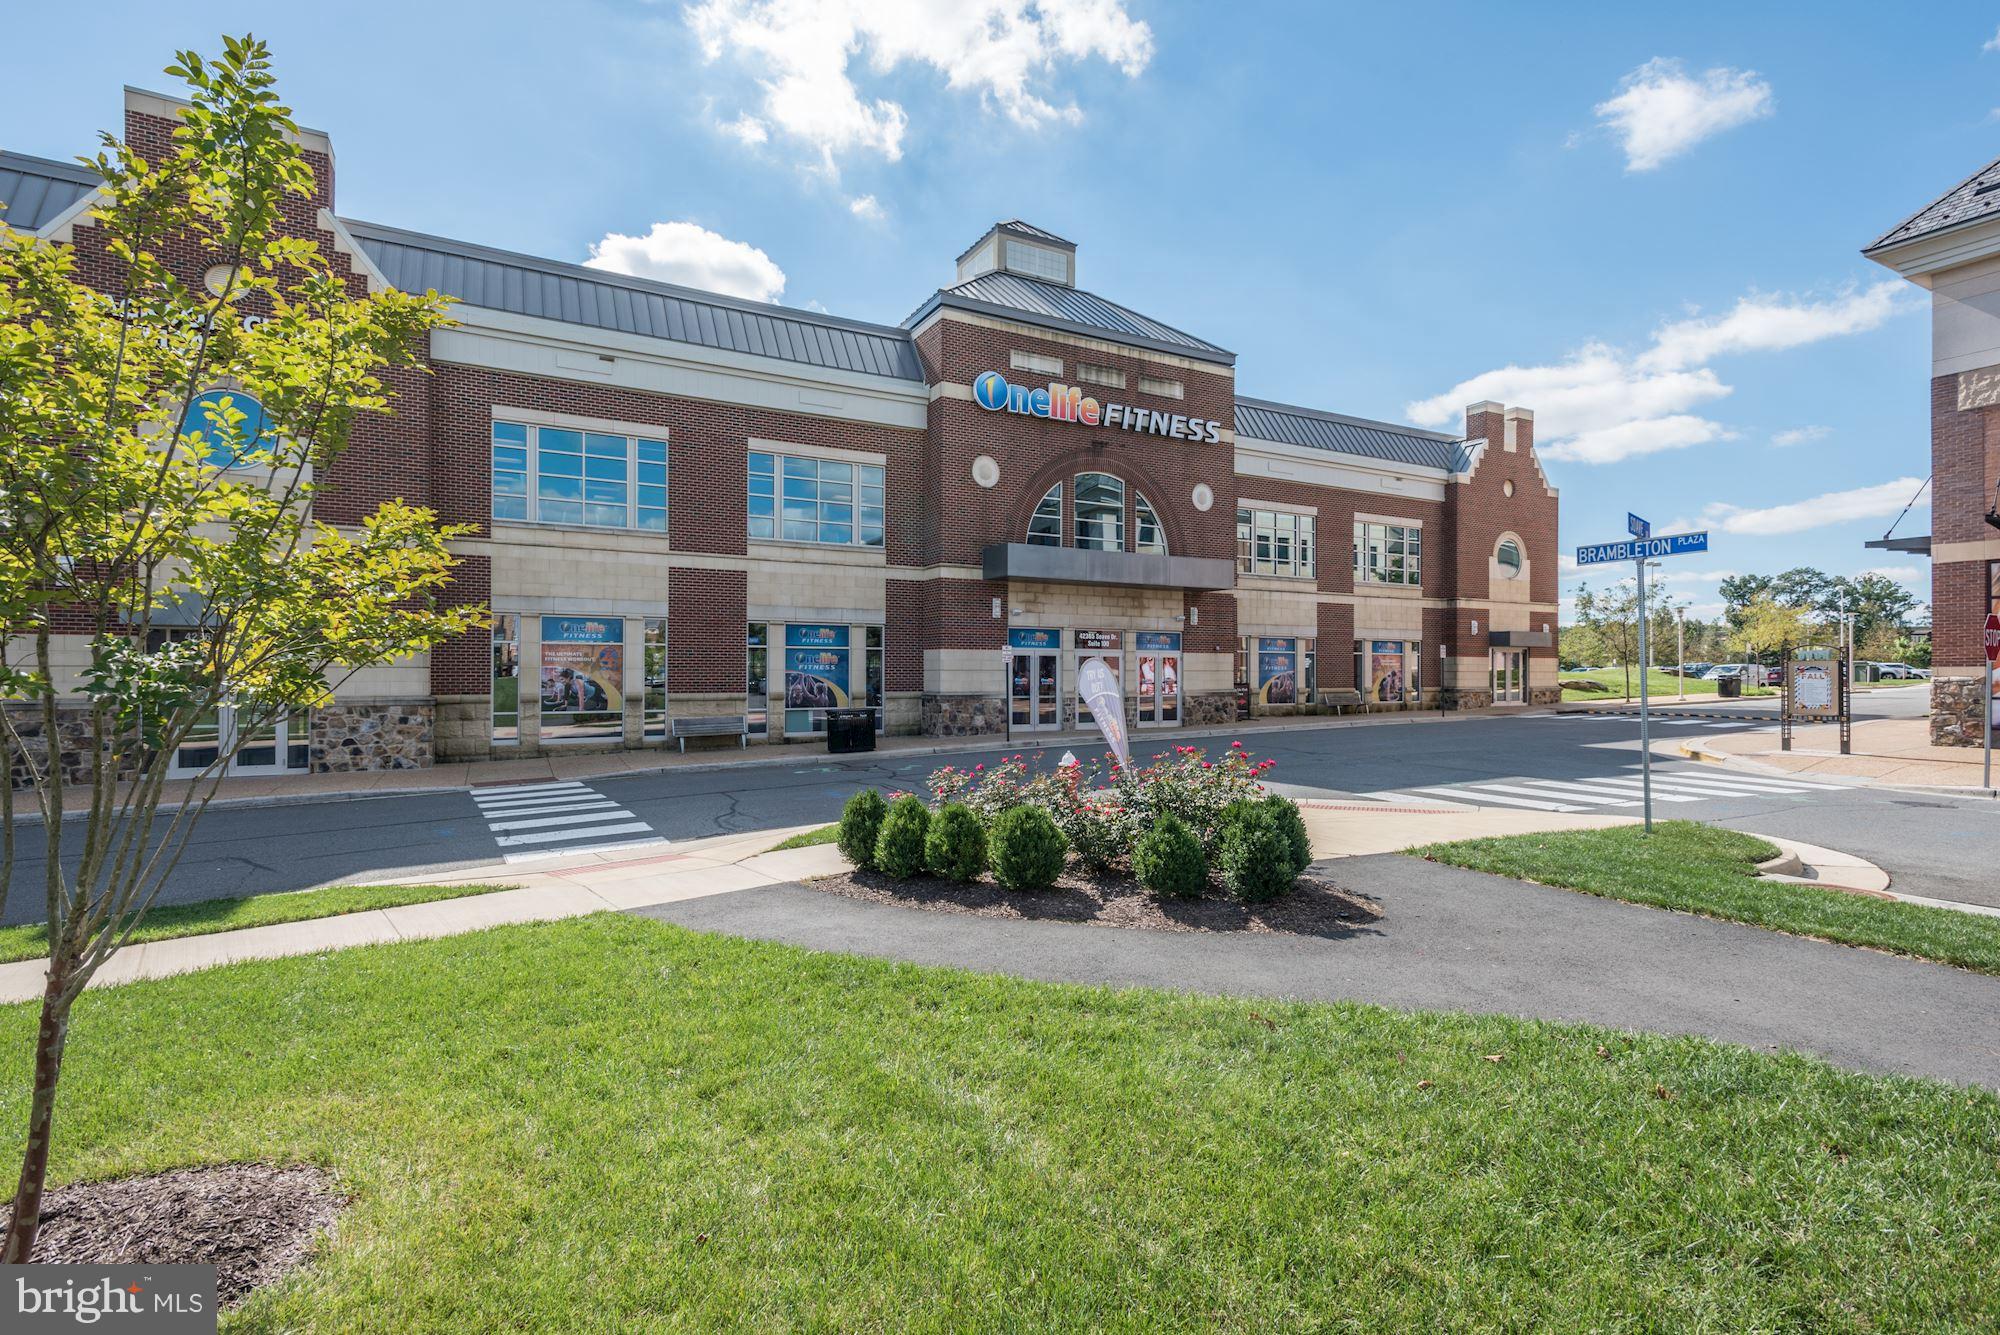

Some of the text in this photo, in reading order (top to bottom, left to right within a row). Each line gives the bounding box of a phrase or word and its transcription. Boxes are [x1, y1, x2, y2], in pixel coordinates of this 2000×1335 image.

[973, 371, 1220, 443] Onelife FITNESS
[1578, 534, 1705, 563] BRAMBLETON PLAZA
[560, 621, 605, 633] Onelife
[795, 652, 839, 665] Onelife
